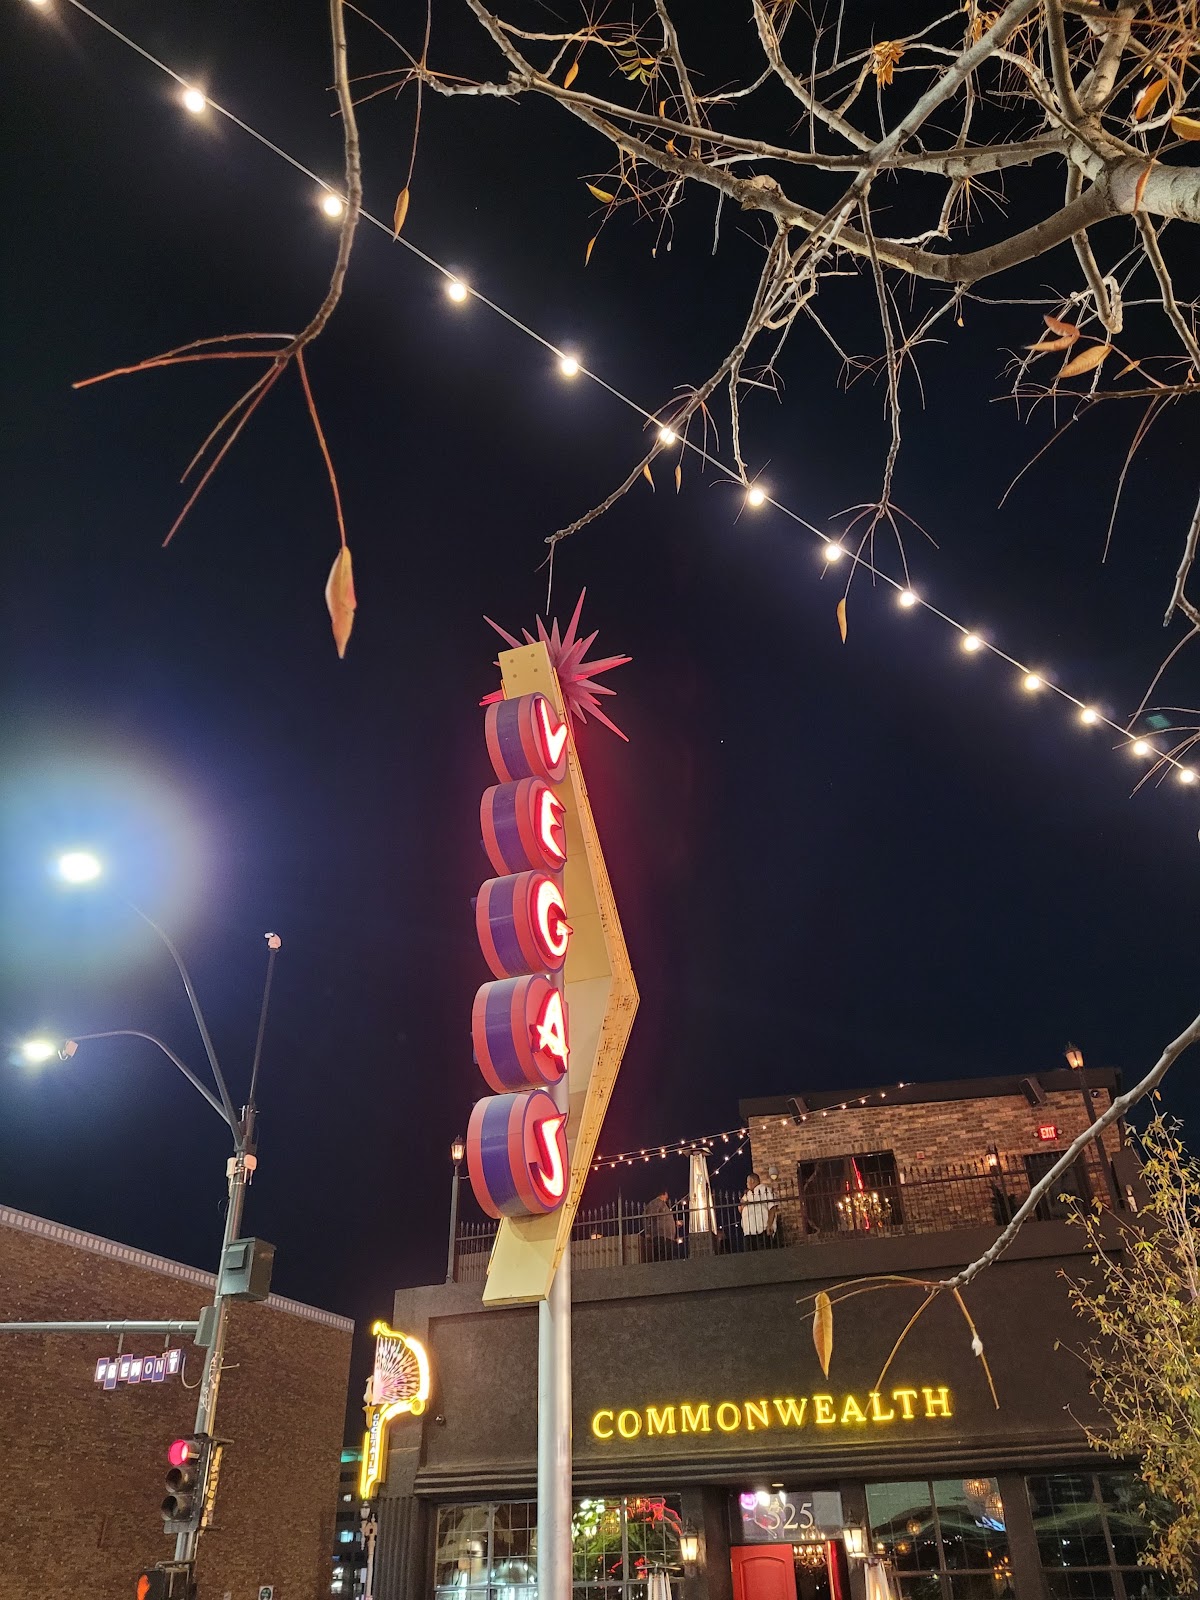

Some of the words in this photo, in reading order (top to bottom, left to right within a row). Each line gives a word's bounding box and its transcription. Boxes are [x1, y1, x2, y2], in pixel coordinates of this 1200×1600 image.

[529, 696, 573, 1201] VEGAS
[1040, 1126, 1056, 1139] EXIT
[97, 1358, 178, 1380] FREMONT
[592, 1387, 953, 1439] COMMONWEALTH
[767, 1502, 814, 1530] 525
